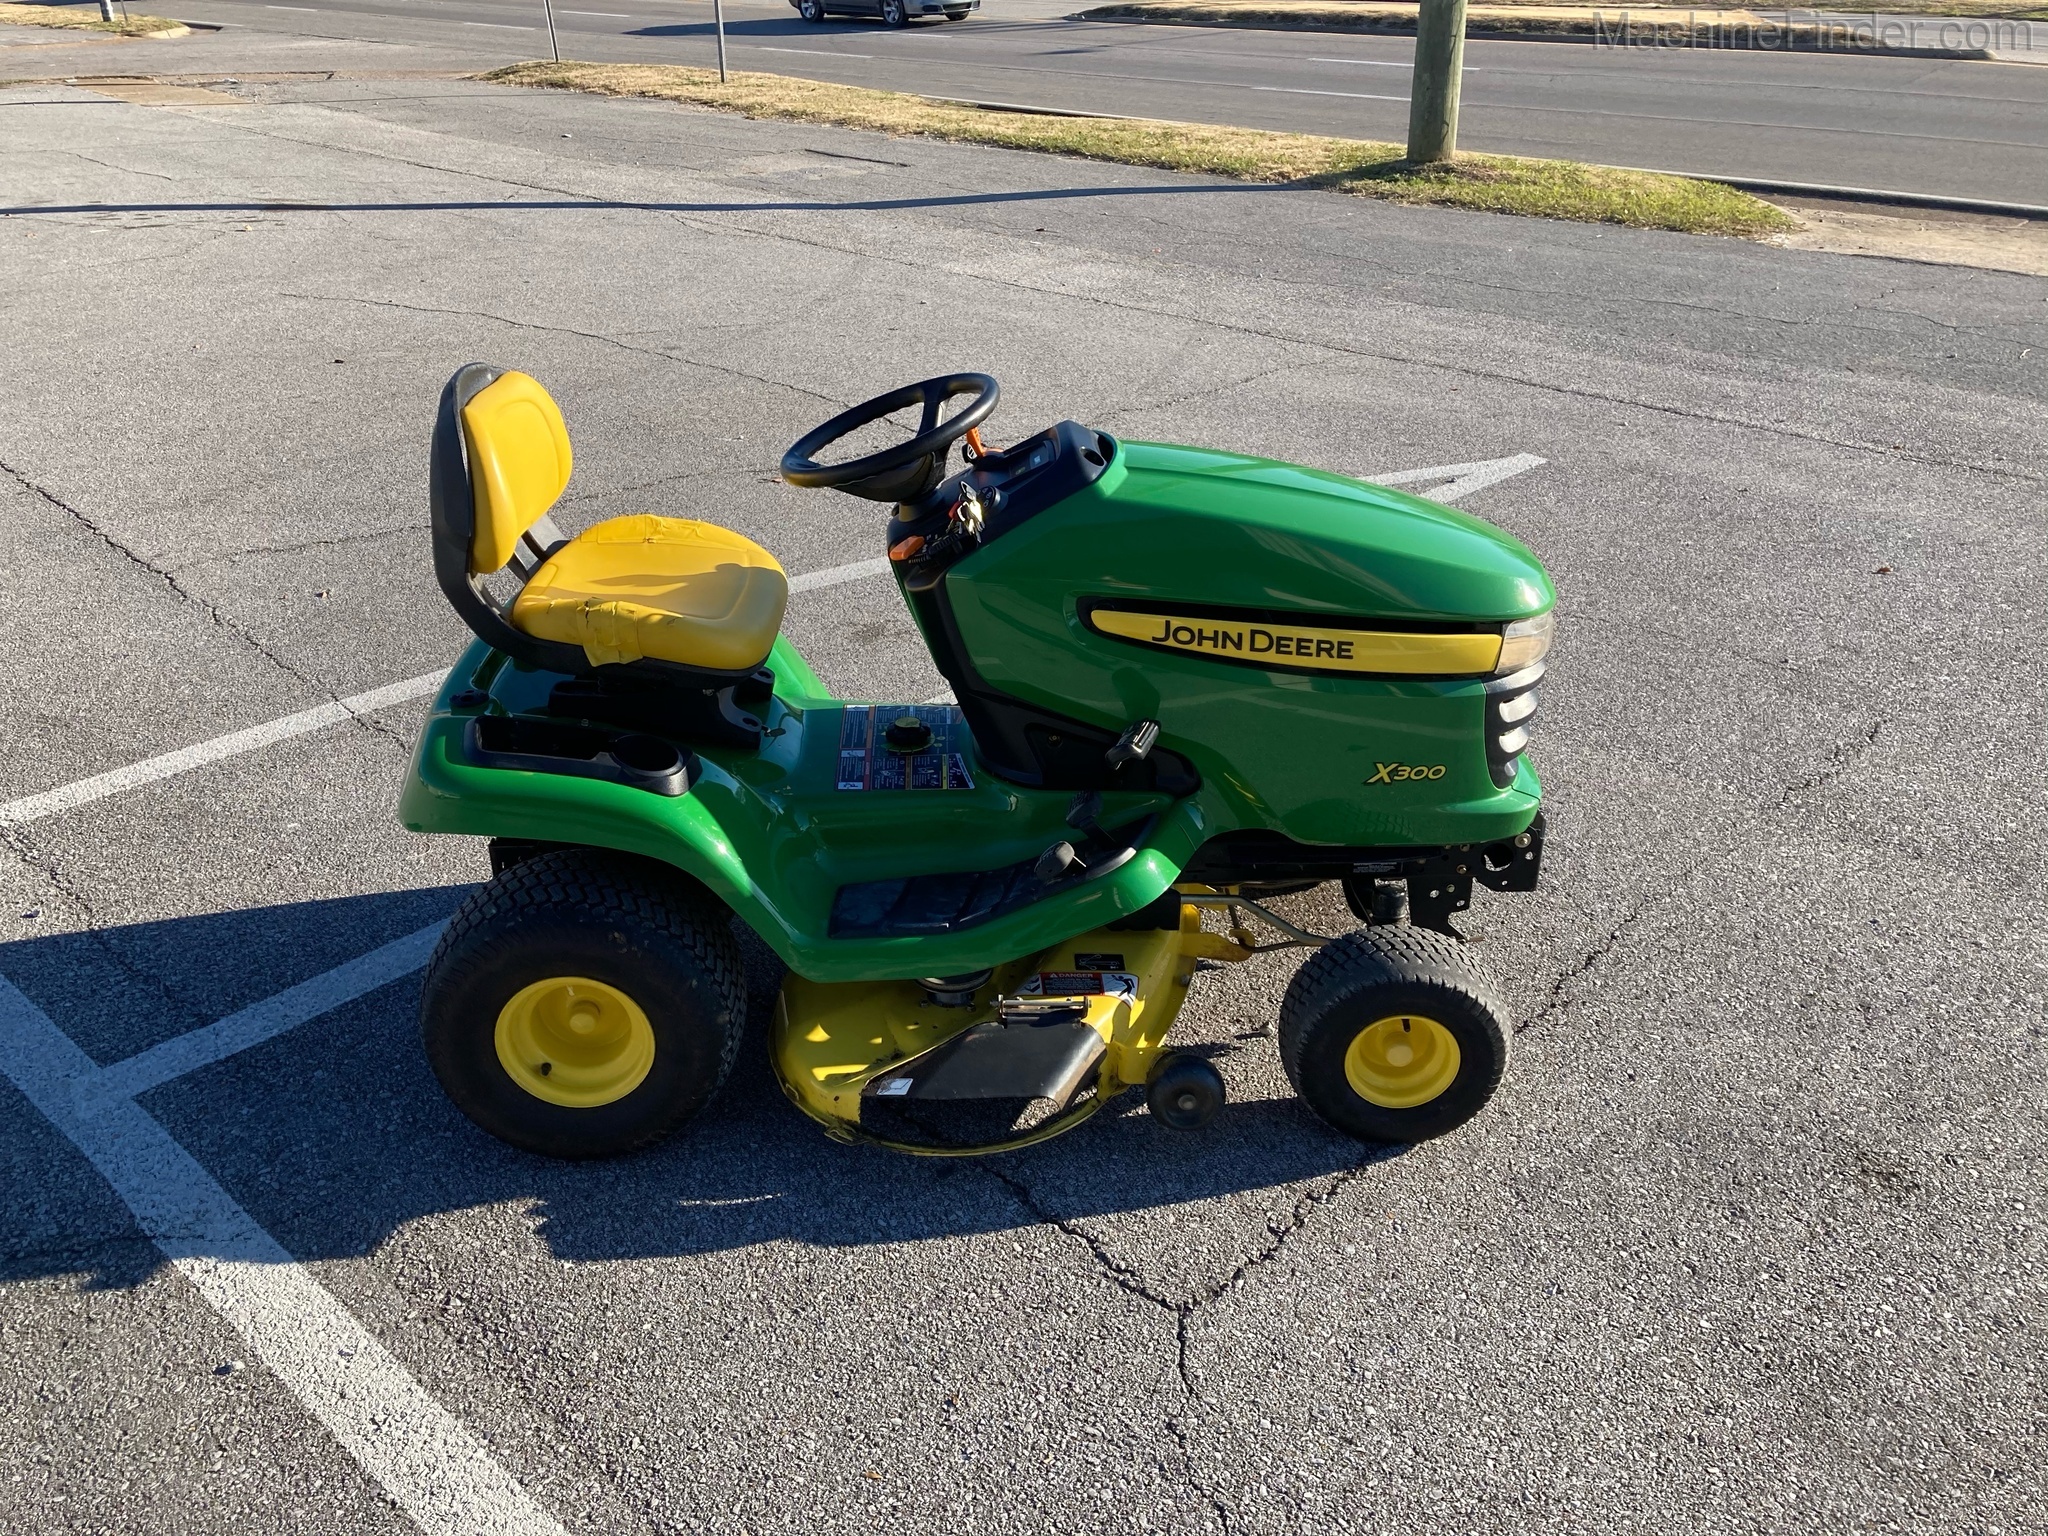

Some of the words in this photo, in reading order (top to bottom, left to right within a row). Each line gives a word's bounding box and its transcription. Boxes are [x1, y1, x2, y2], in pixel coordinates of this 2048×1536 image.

[1152, 620, 1243, 650] JOHN
[1249, 629, 1354, 660] DEERE
[1363, 762, 1447, 785] X300
